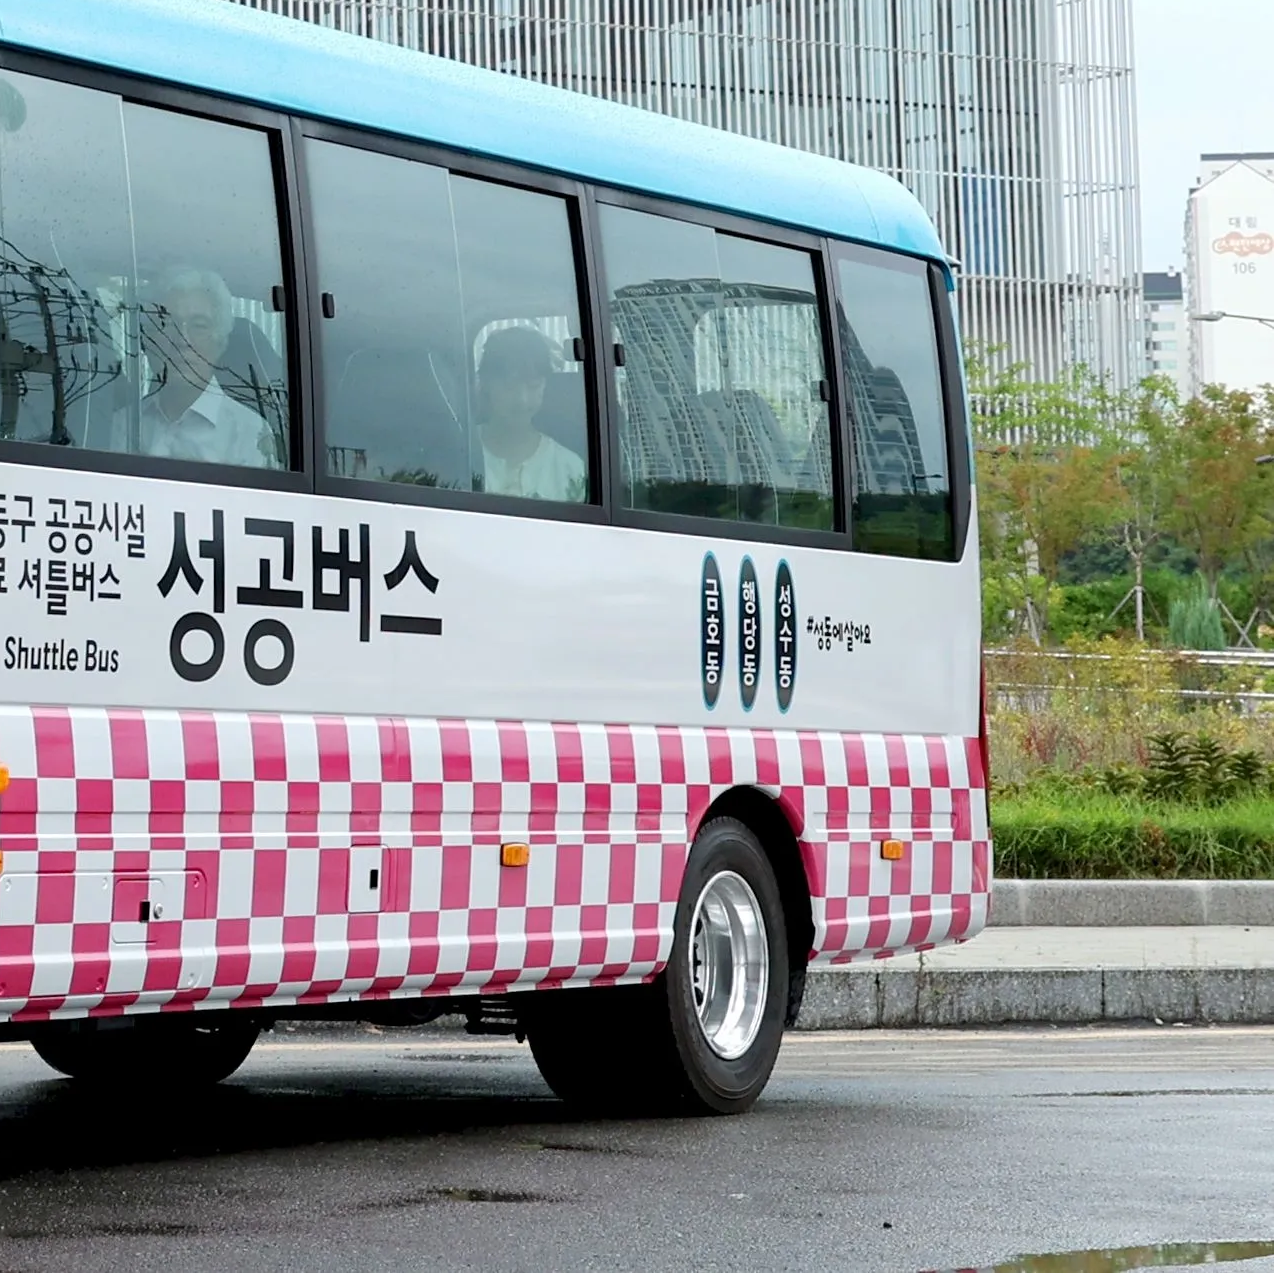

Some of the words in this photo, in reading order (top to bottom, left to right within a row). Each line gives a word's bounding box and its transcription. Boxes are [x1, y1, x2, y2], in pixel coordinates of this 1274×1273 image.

[1232, 262, 1257, 275] 106
[45, 498, 146, 559] 공공시설
[17, 558, 122, 616] 셔틀버스
[156, 509, 443, 687] 성공버스
[3, 636, 79, 672] Shuttle
[84, 639, 119, 673] Bus
[704, 578, 720, 685] 금호동
[742, 580, 758, 687] 행당동
[778, 584, 793, 688] 성수동
[806, 616, 872, 652] #성동에살아요
